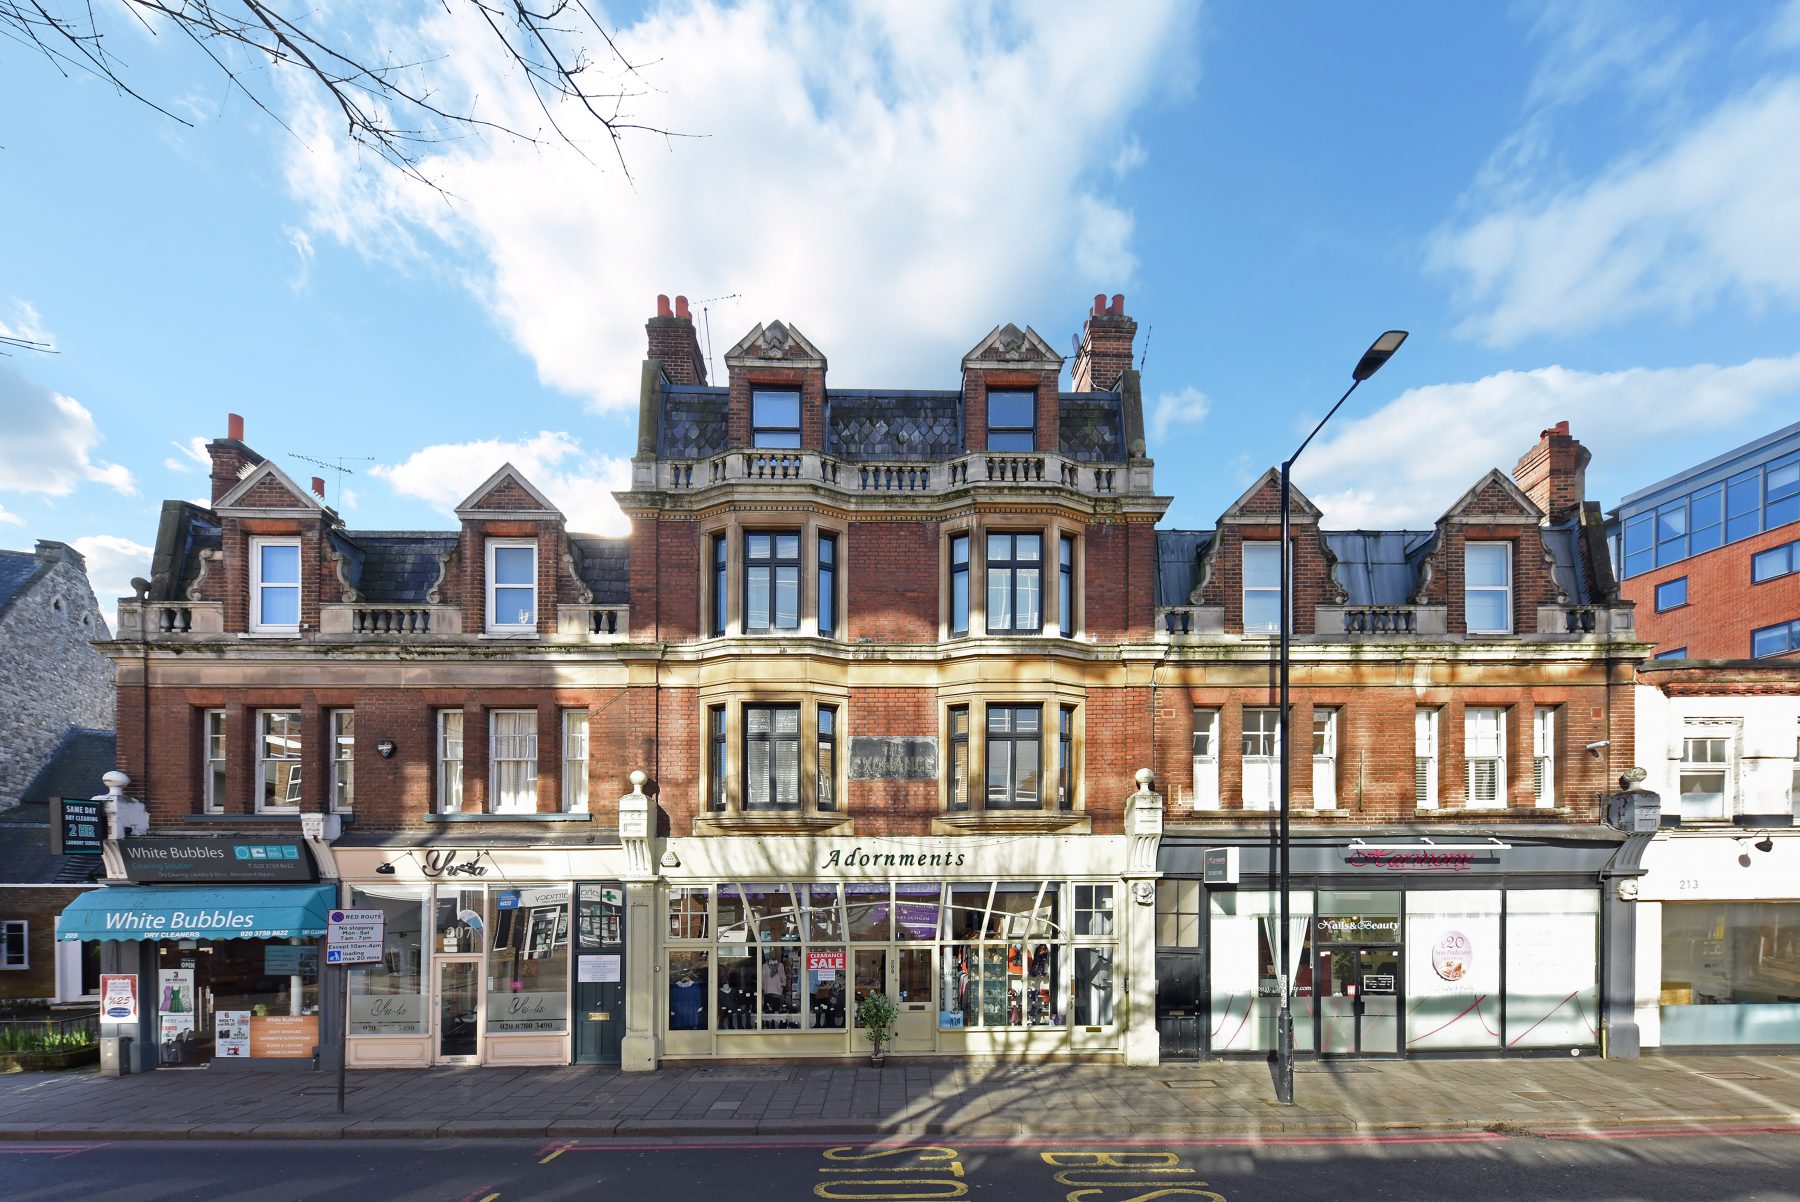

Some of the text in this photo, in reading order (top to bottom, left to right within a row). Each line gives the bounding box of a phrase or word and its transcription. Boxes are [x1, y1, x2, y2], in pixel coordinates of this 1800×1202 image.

[851, 756, 934, 772] EXCHANGE
[66, 805, 83, 814] SAME
[69, 824, 95, 837] 2 HR
[127, 847, 224, 858] White Bubbles
[822, 848, 965, 869] Adornments
[1680, 880, 1698, 890] 213
[106, 910, 254, 929] White Bubbles
[810, 958, 844, 968] SALE
[813, 1146, 971, 1202] STO
